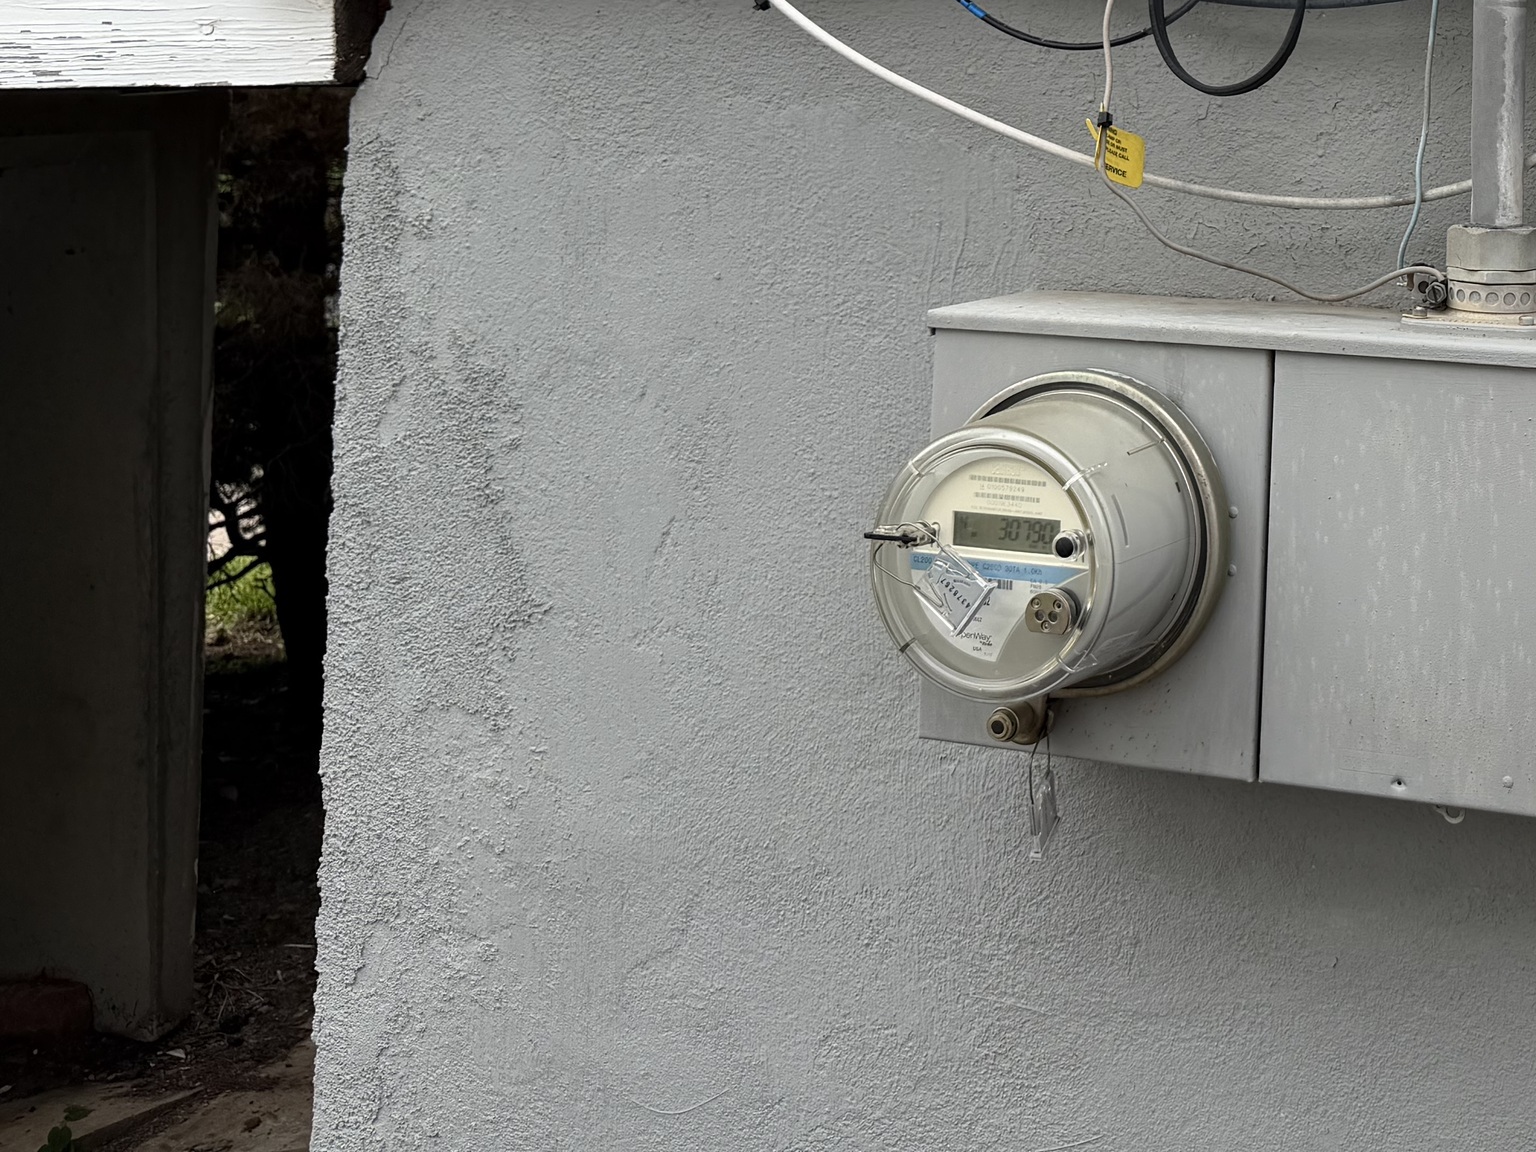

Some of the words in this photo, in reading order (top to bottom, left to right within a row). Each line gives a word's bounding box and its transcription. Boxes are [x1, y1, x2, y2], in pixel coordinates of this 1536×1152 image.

[1118, 153, 1129, 161] CALL
[1105, 163, 1127, 178] ERVICE
[940, 578, 970, 608] 4378267
[961, 632, 992, 642] penWay
